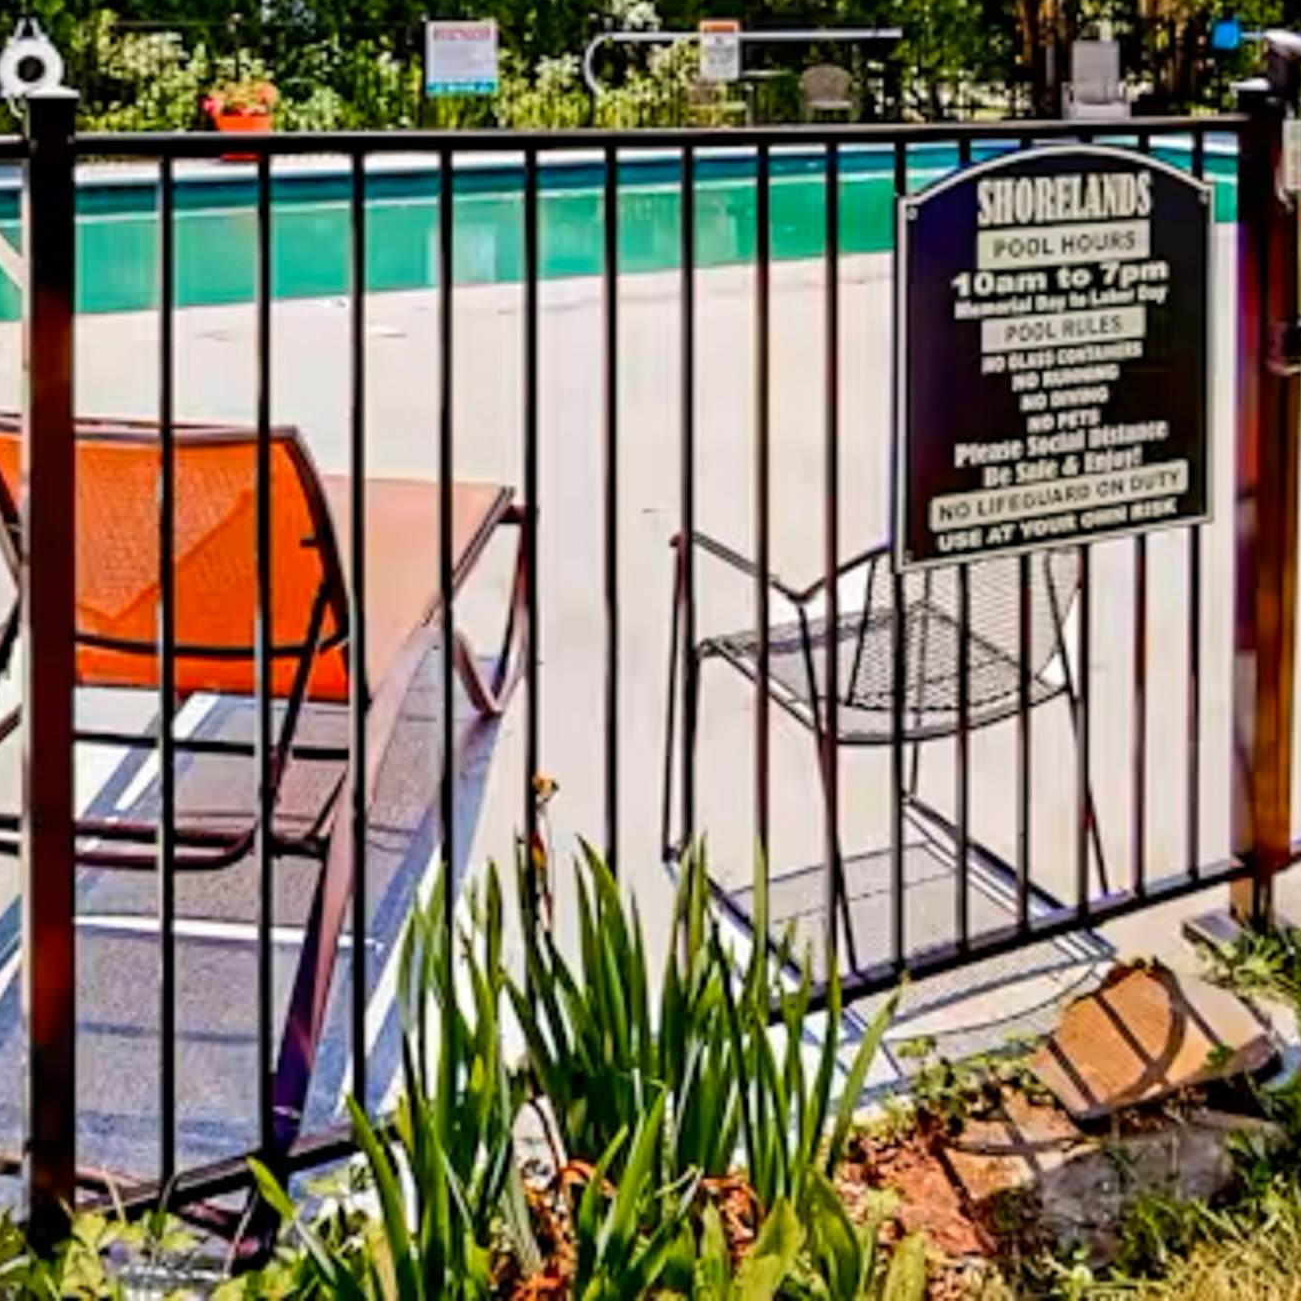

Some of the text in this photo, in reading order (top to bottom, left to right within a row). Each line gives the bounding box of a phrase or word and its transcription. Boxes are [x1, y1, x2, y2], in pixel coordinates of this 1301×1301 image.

[978, 173, 1151, 225] SHORELANDS
[993, 232, 1135, 258] POOL HOURS
[951, 262, 1170, 297] 10am to 7pm
[954, 298, 1033, 320] Memorial
[1035, 296, 1067, 314] Day
[1091, 289, 1135, 306] Labor
[1137, 285, 1169, 305] Day
[1005, 315, 1124, 344] POOL RULES
[981, 356, 1006, 374] NO
[1011, 372, 1040, 392] NO
[1019, 394, 1048, 412] NO
[1026, 409, 1101, 434] NO PETS
[954, 421, 1169, 468] Please Social Distance
[983, 466, 1013, 487] Be
[1015, 460, 1059, 483] Safe
[1062, 456, 1079, 476] &
[939, 470, 1181, 522] NO LIFEGUARD ON DUTY
[937, 498, 1177, 550] USE AT YOUR OWN RISK
